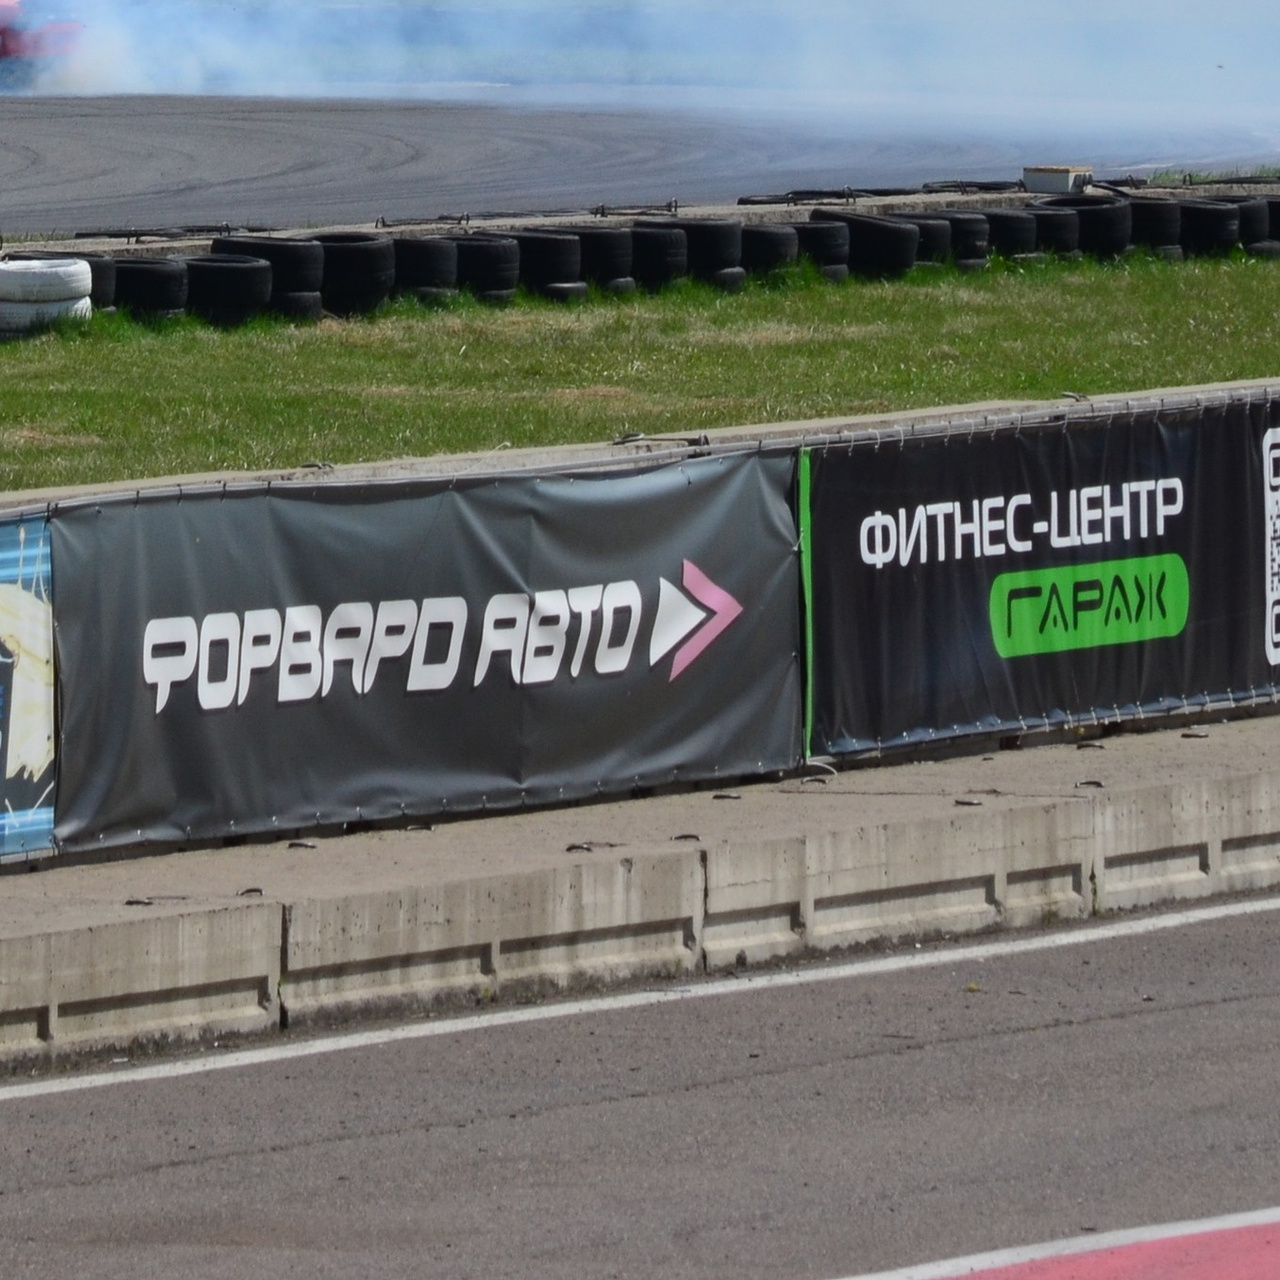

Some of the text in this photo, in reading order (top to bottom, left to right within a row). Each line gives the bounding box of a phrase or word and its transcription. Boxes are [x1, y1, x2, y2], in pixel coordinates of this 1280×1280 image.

[860, 477, 1184, 569] ФИТНЕС-ЦЕНТР
[473, 580, 641, 688] АВТО
[1006, 570, 1168, 639] ГАРАЖ
